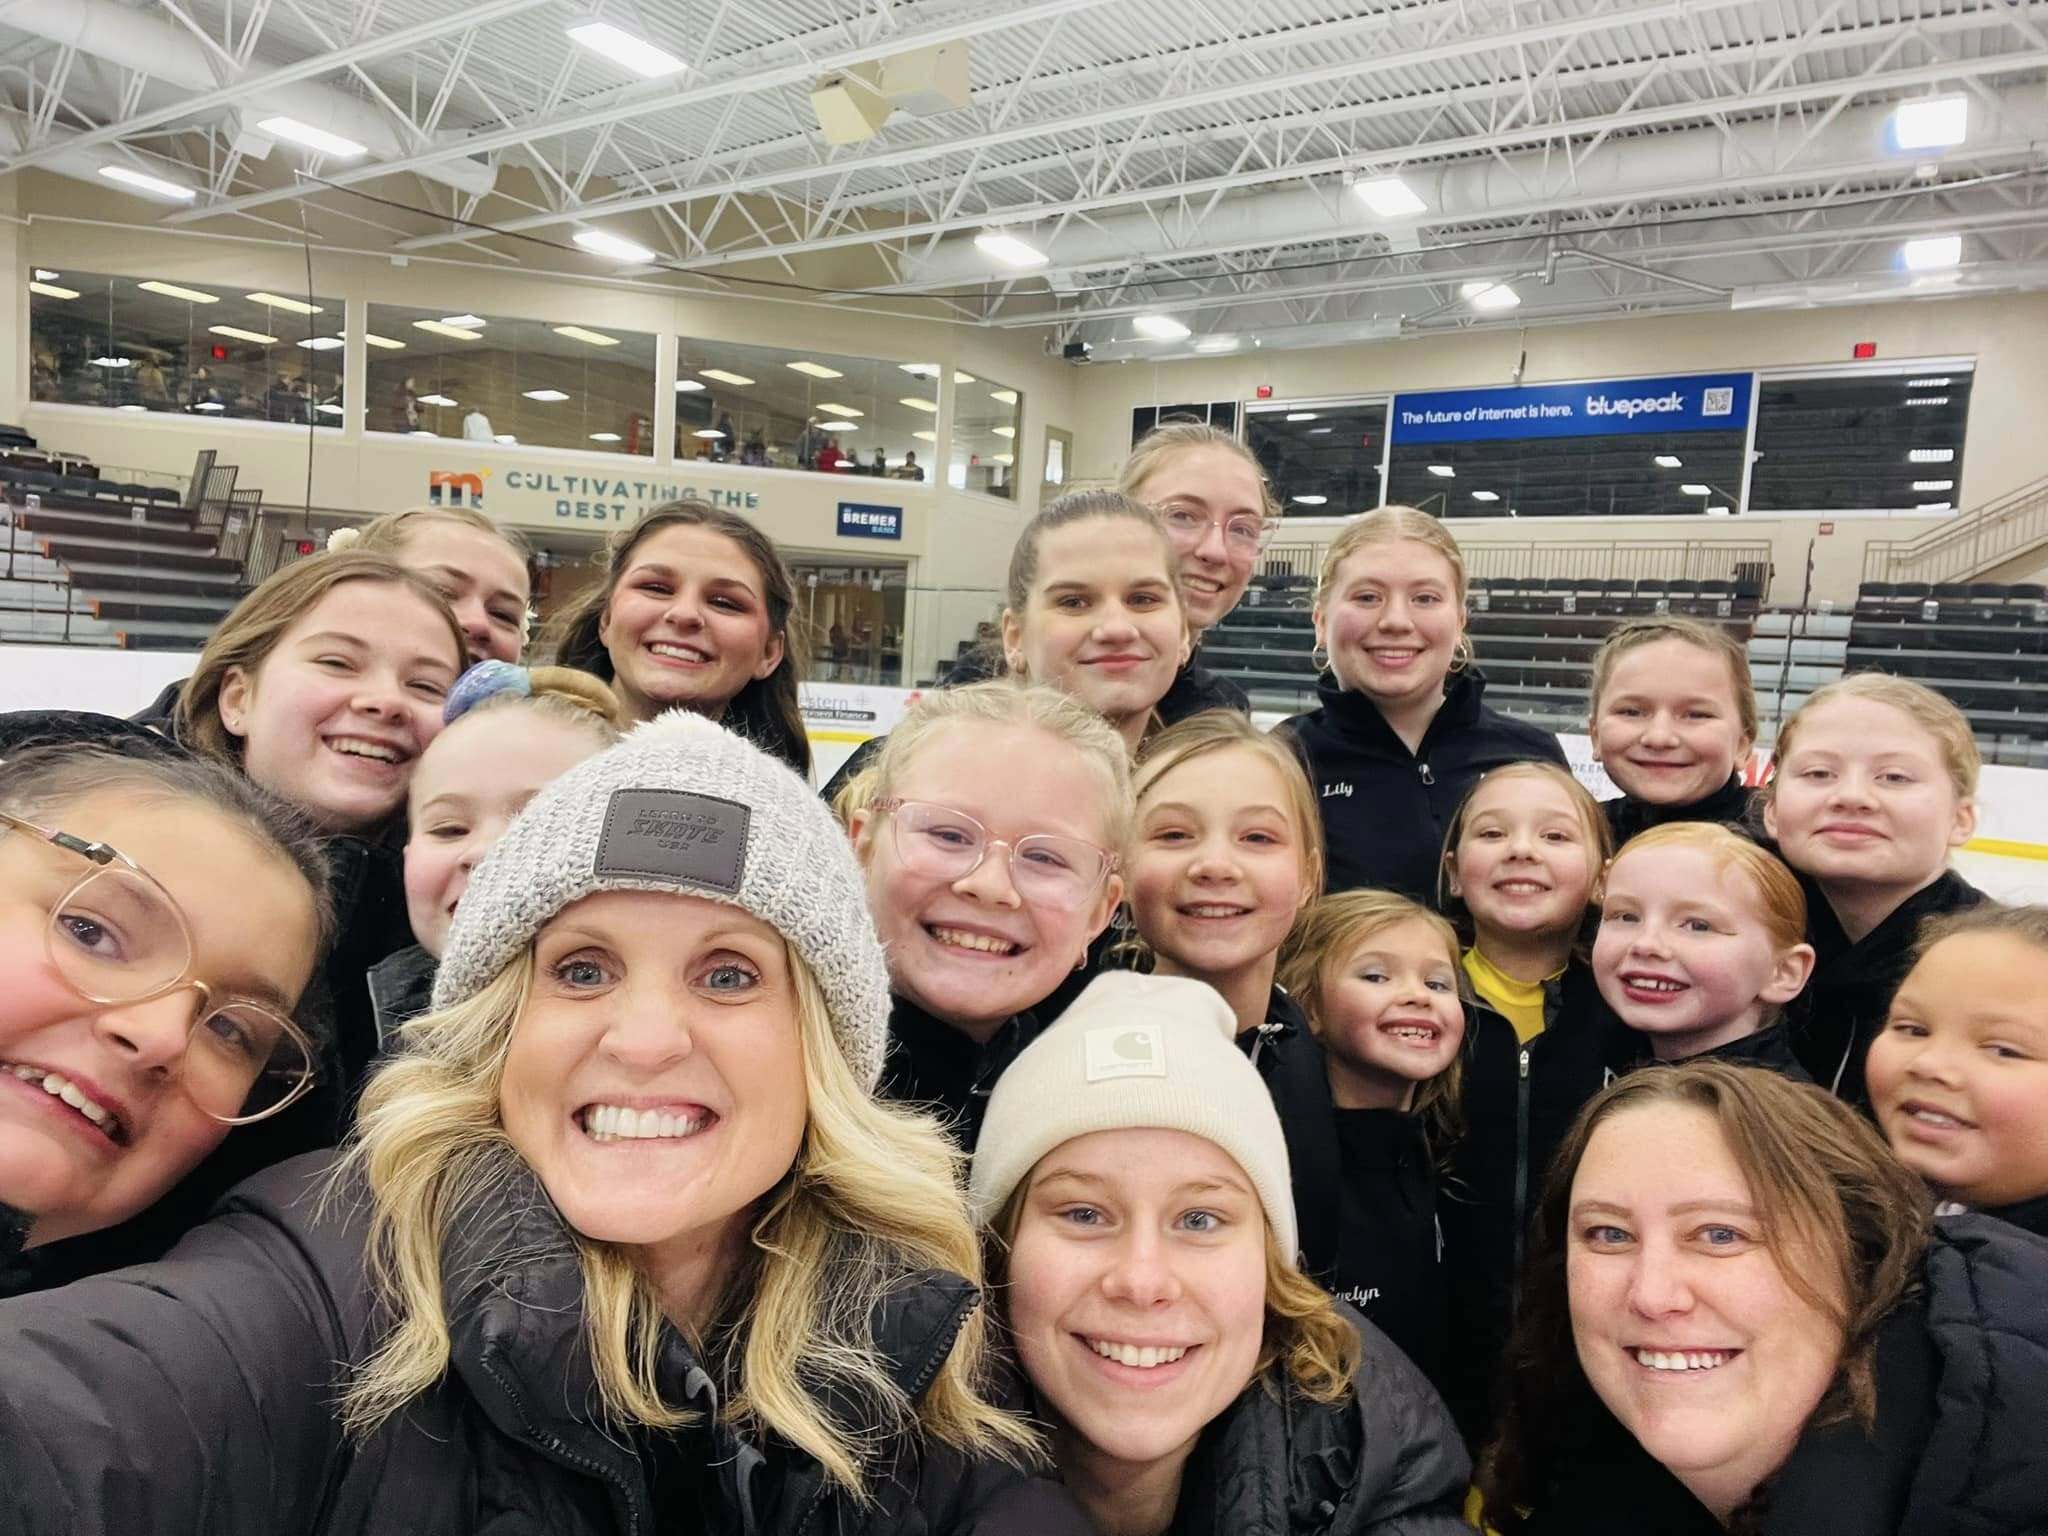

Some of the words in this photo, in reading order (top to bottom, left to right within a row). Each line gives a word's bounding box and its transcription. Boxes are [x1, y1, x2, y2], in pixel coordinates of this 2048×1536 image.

[1401, 412, 1424, 425] The
[1425, 409, 1462, 424] future
[1463, 408, 1477, 422] of
[1478, 405, 1527, 421] internet
[1528, 404, 1539, 418] is
[1540, 403, 1573, 417] here.
[1586, 391, 1683, 419] bluepeak
[506, 471, 697, 500] CULTIVATING
[709, 488, 760, 509] THE
[556, 500, 625, 521] BEST
[843, 512, 897, 527] BREMER
[871, 525, 896, 534] BANK
[1322, 782, 1353, 798] Lily
